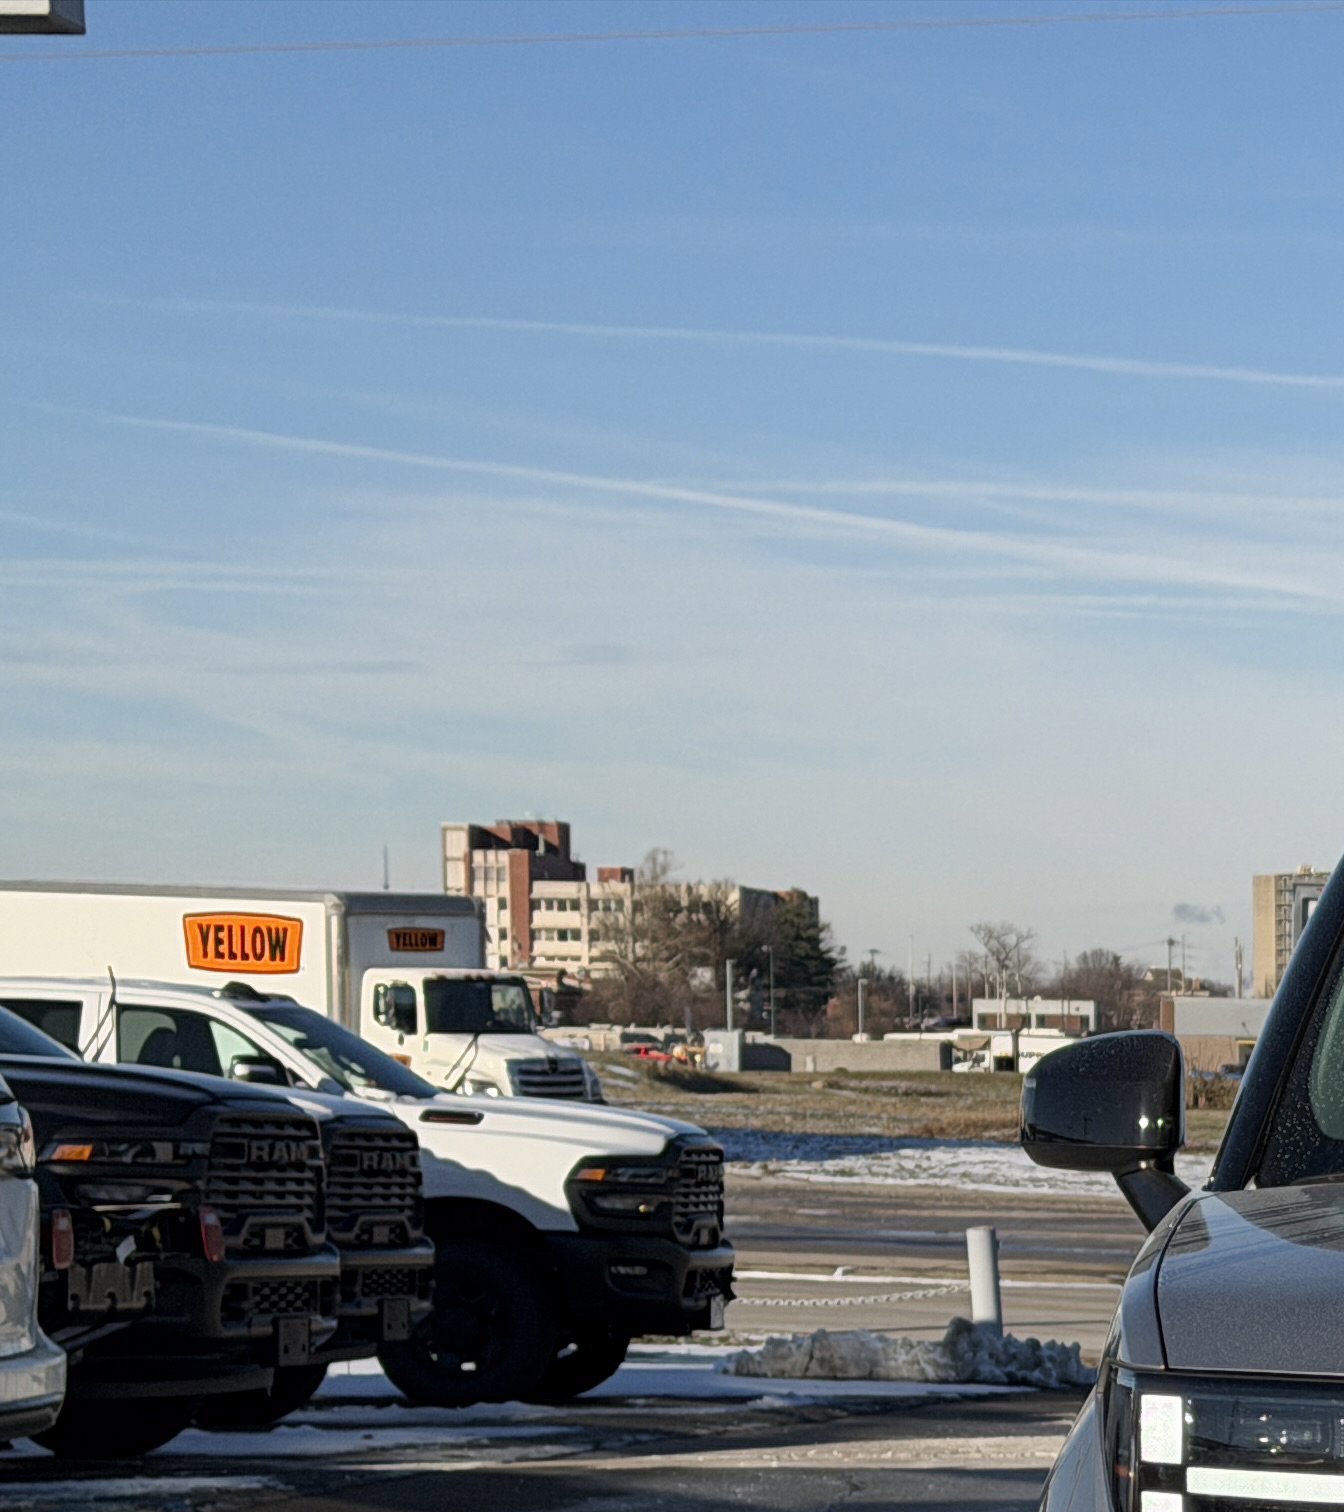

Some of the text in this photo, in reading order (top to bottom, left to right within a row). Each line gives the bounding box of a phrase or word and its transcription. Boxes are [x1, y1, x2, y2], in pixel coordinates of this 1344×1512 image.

[197, 923, 289, 963] YELLOW
[394, 932, 438, 948] YELLOW
[361, 1150, 409, 1171] RAM
